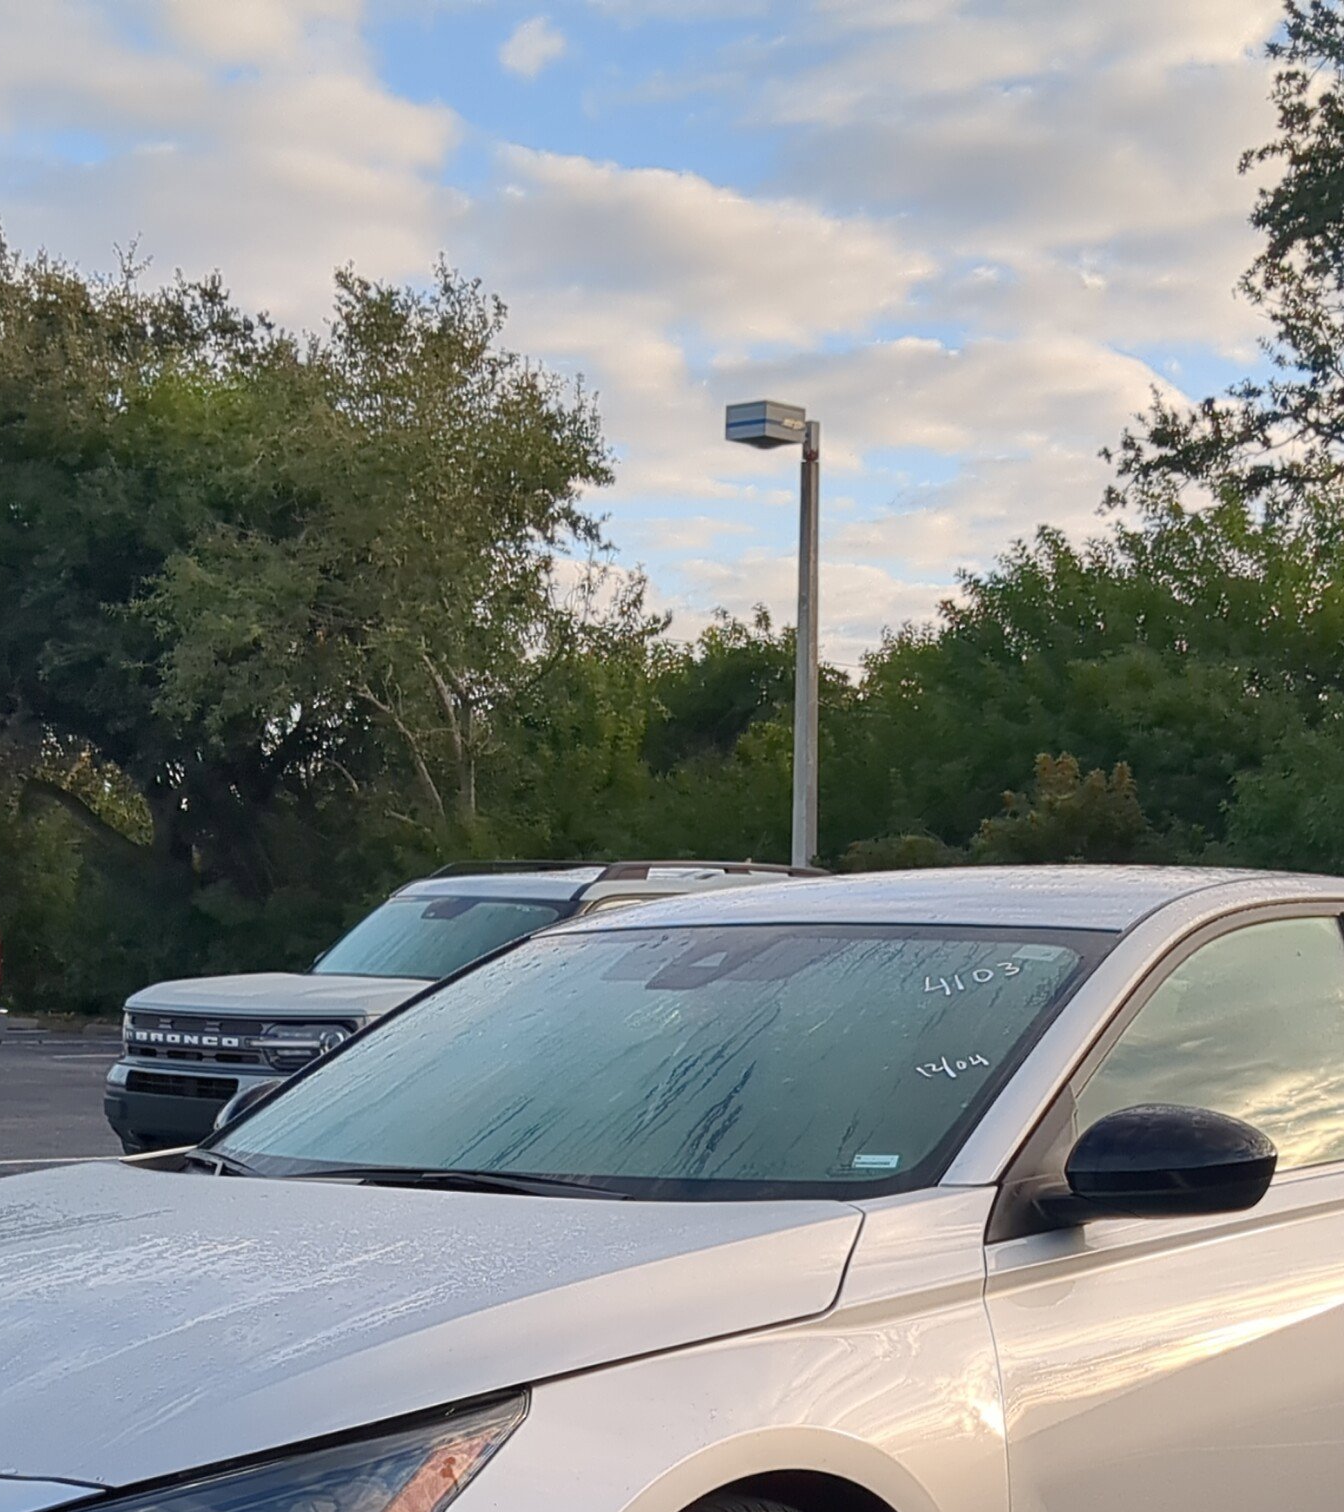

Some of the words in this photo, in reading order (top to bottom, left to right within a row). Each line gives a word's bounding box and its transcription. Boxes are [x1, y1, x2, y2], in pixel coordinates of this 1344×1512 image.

[924, 961, 1020, 996] 4103
[136, 1031, 239, 1047] BRONCO
[916, 1053, 990, 1079] 12/04
